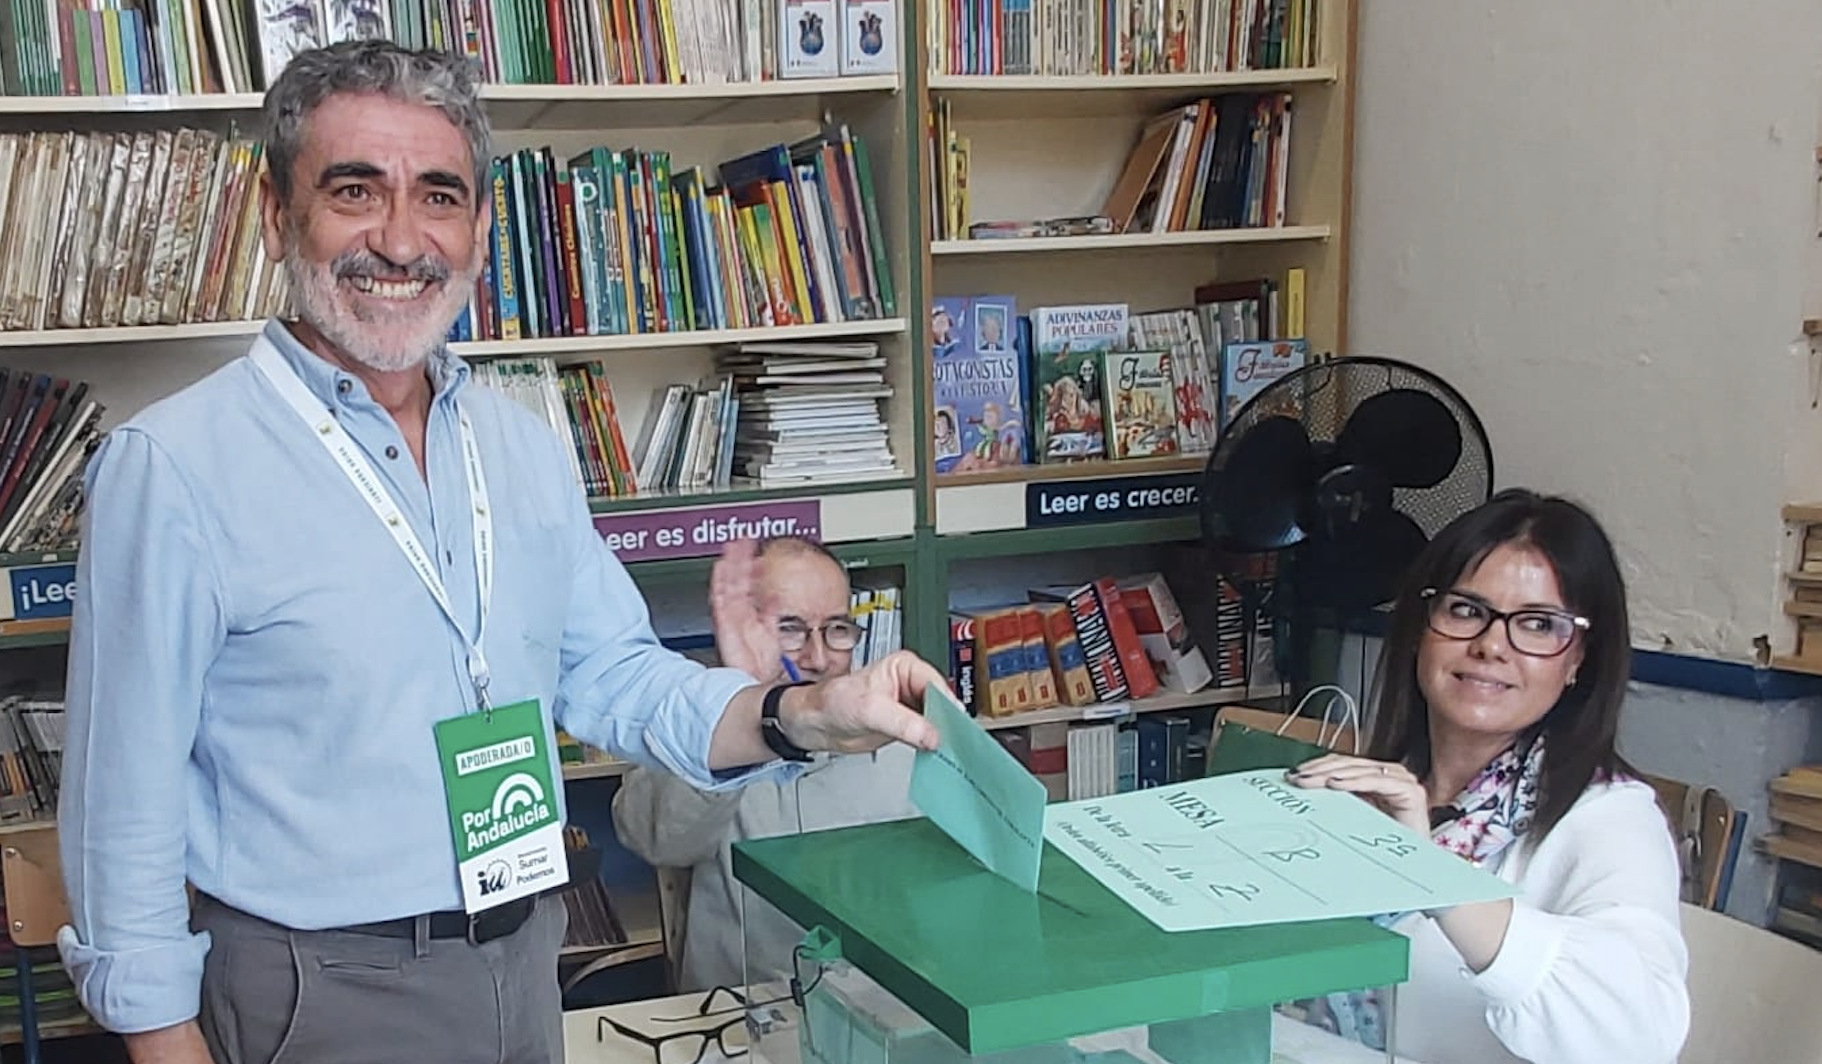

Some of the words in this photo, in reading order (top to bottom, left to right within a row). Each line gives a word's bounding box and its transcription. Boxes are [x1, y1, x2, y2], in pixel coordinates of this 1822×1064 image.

[1046, 309, 1122, 326] ADIVINANZAS
[1051, 323, 1118, 337] POPULARES
[1040, 492, 1089, 515] Leer
[1095, 491, 1120, 510] es
[1128, 486, 1199, 508] crecer.
[603, 530, 648, 550] eer
[655, 527, 684, 547] es
[692, 516, 817, 544] disfrutar...
[20, 578, 79, 611] ¡Lee
[460, 740, 532, 771] APODERADA/O
[1159, 791, 1225, 829] MESA
[1243, 776, 1315, 815] SECCIÓN
[462, 808, 491, 833] Por
[467, 803, 549, 852] Andalucía
[516, 867, 556, 885] Podemos
[518, 854, 548, 870] Sumar
